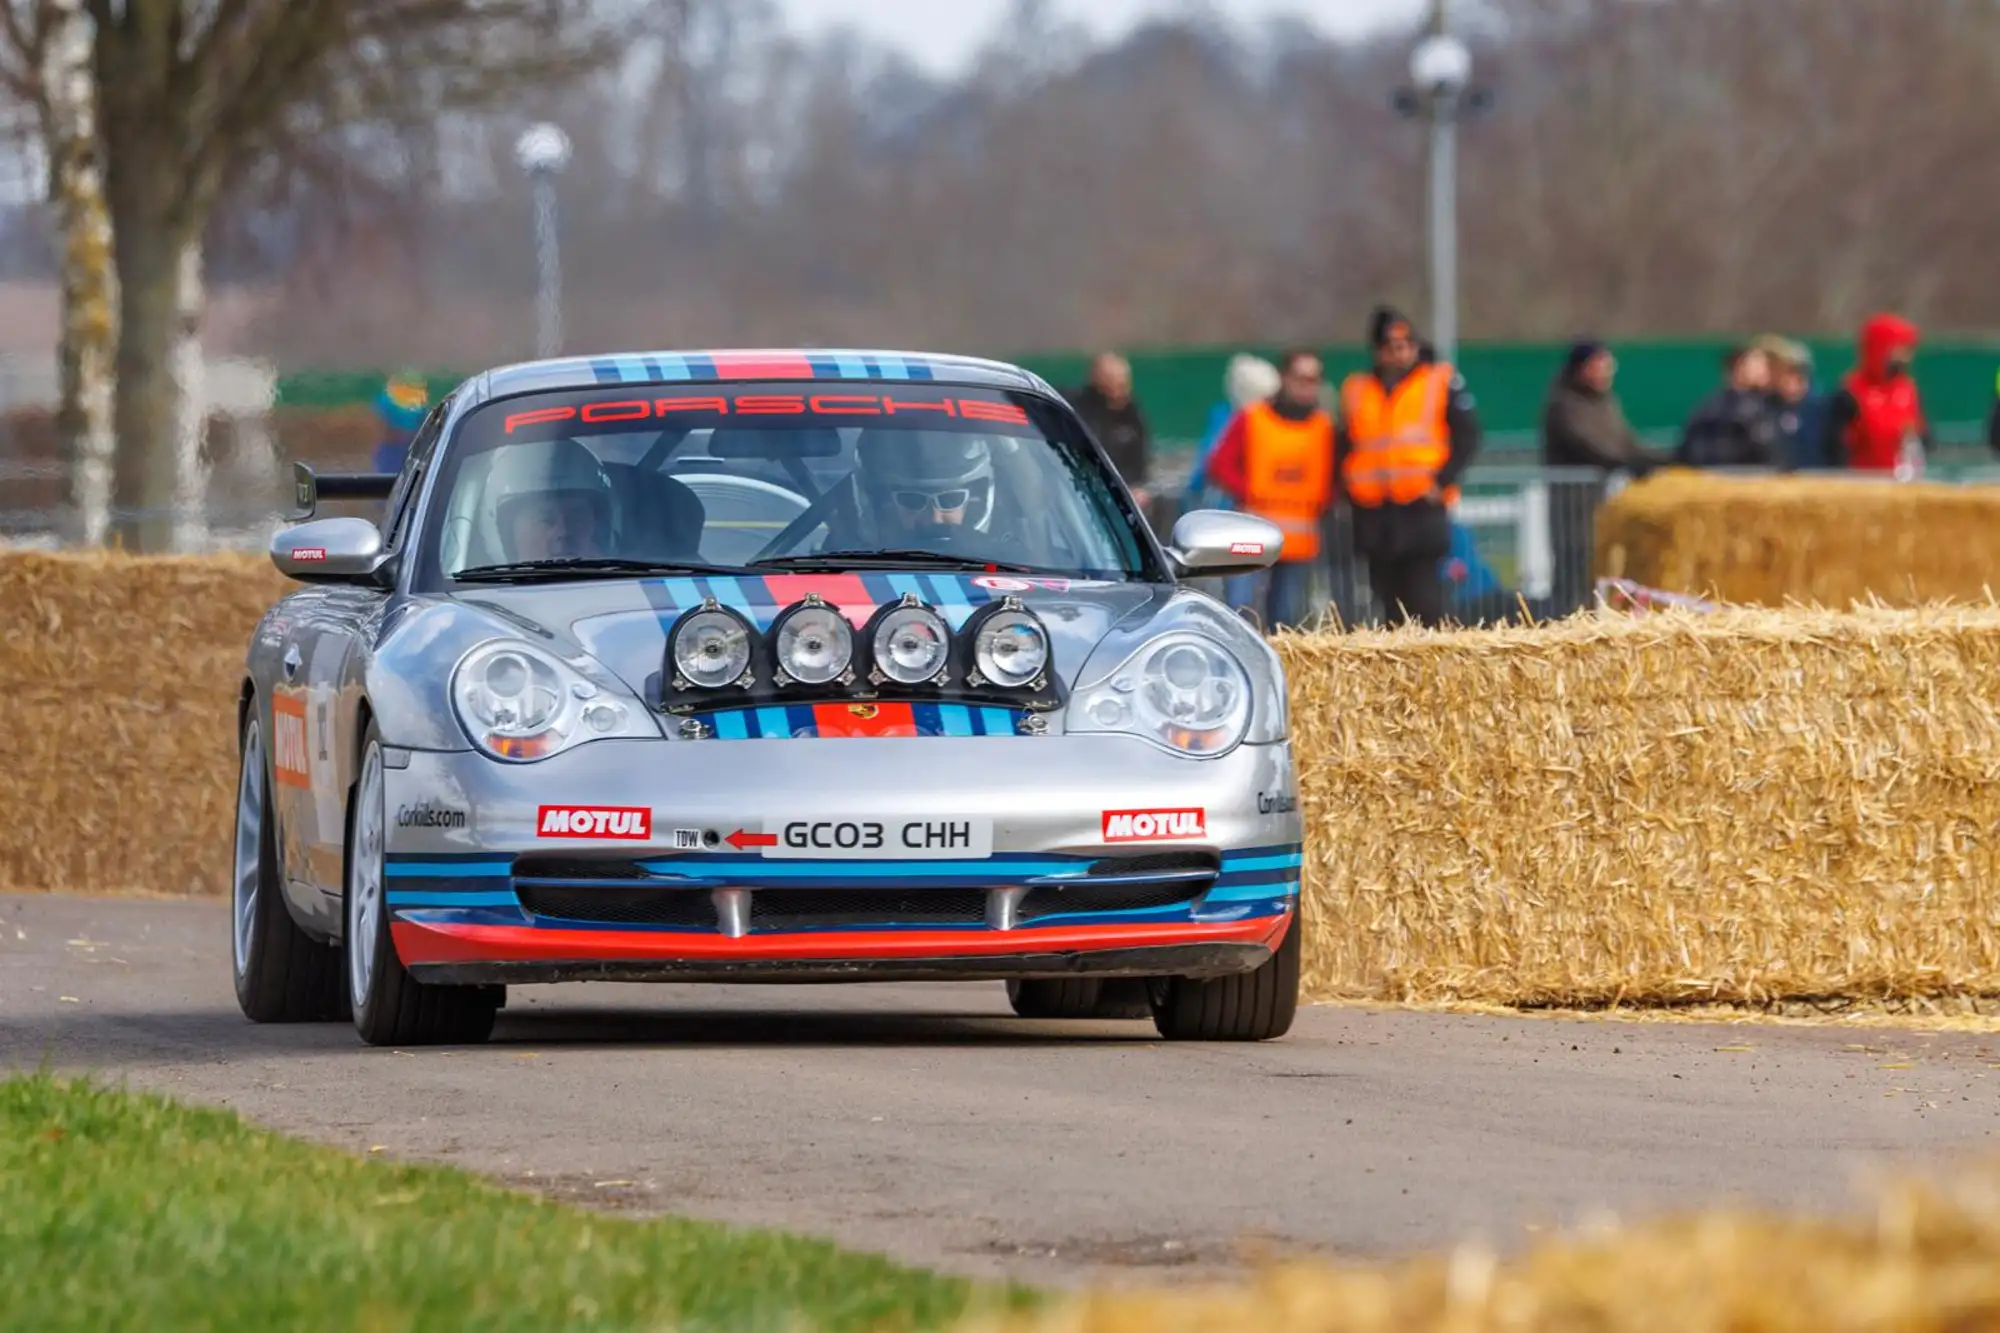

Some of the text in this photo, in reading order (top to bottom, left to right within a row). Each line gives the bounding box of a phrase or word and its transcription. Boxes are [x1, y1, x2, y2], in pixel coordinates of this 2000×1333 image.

[504, 395, 1029, 434] PORSCHE
[293, 549, 324, 560] MOTUL
[541, 810, 646, 835] MOTUL
[902, 821, 971, 848] CHH
[1105, 811, 1204, 837] MOTUL
